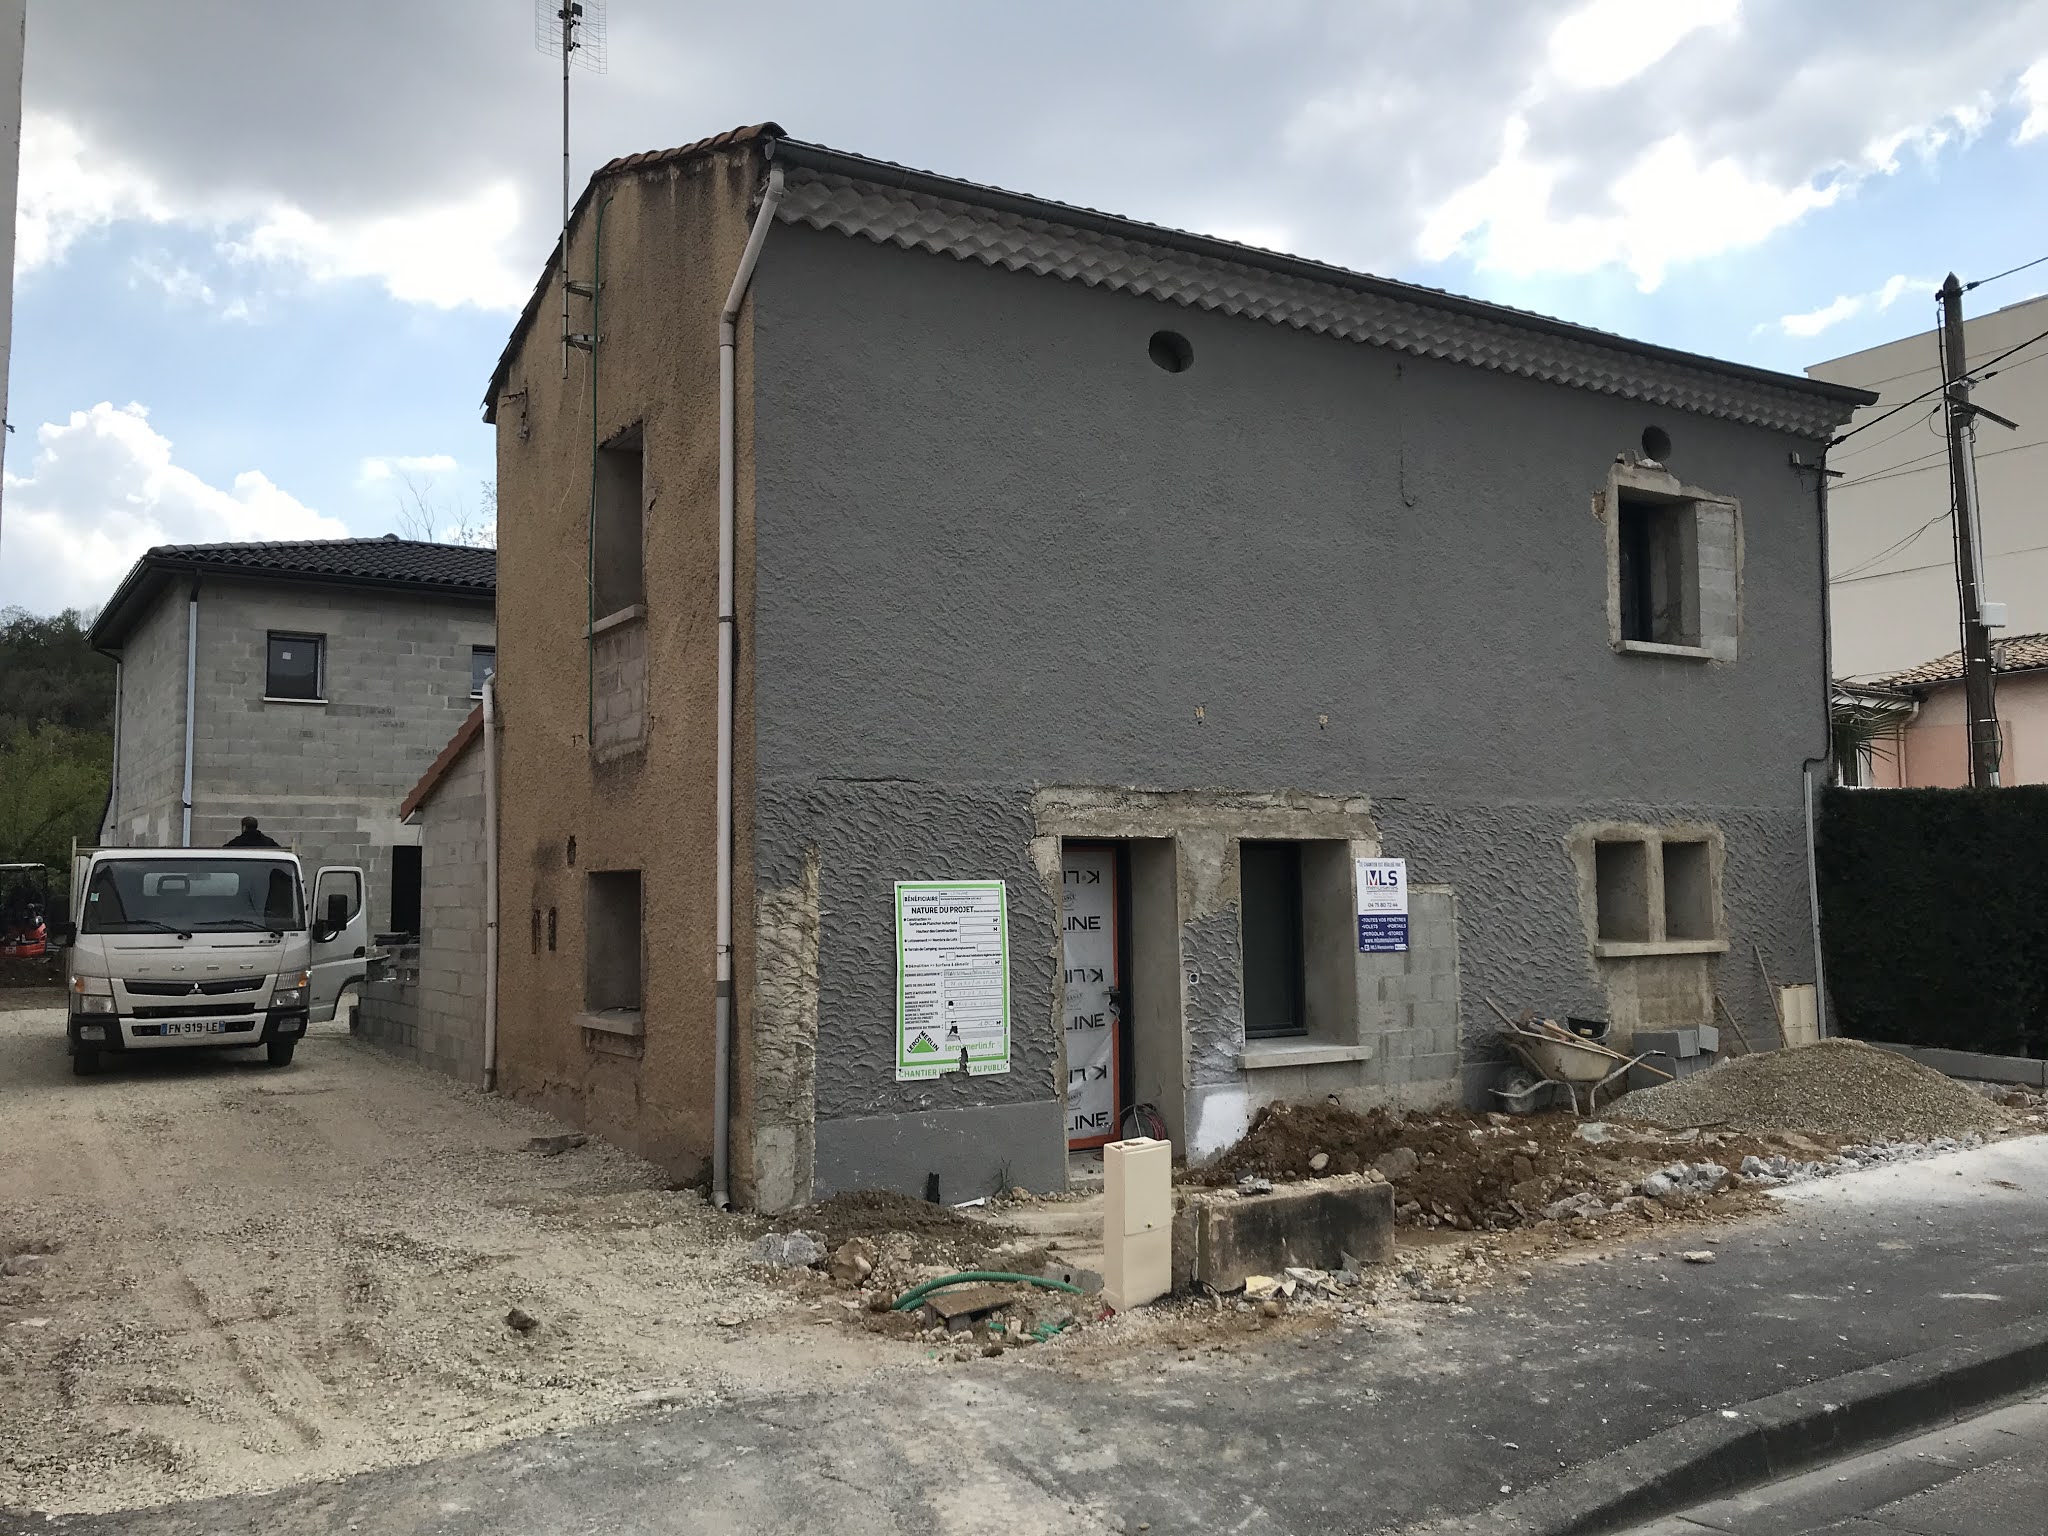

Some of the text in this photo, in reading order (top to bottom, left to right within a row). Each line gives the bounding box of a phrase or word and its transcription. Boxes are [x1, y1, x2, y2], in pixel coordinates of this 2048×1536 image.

[1366, 870, 1398, 886] MLS
[912, 906, 974, 914] NATURE DU PROJET
[906, 1030, 940, 1053] LEROY MERLIN
[898, 1069, 936, 1078] CHANTIER
[984, 1063, 1007, 1071] PUBLIC
